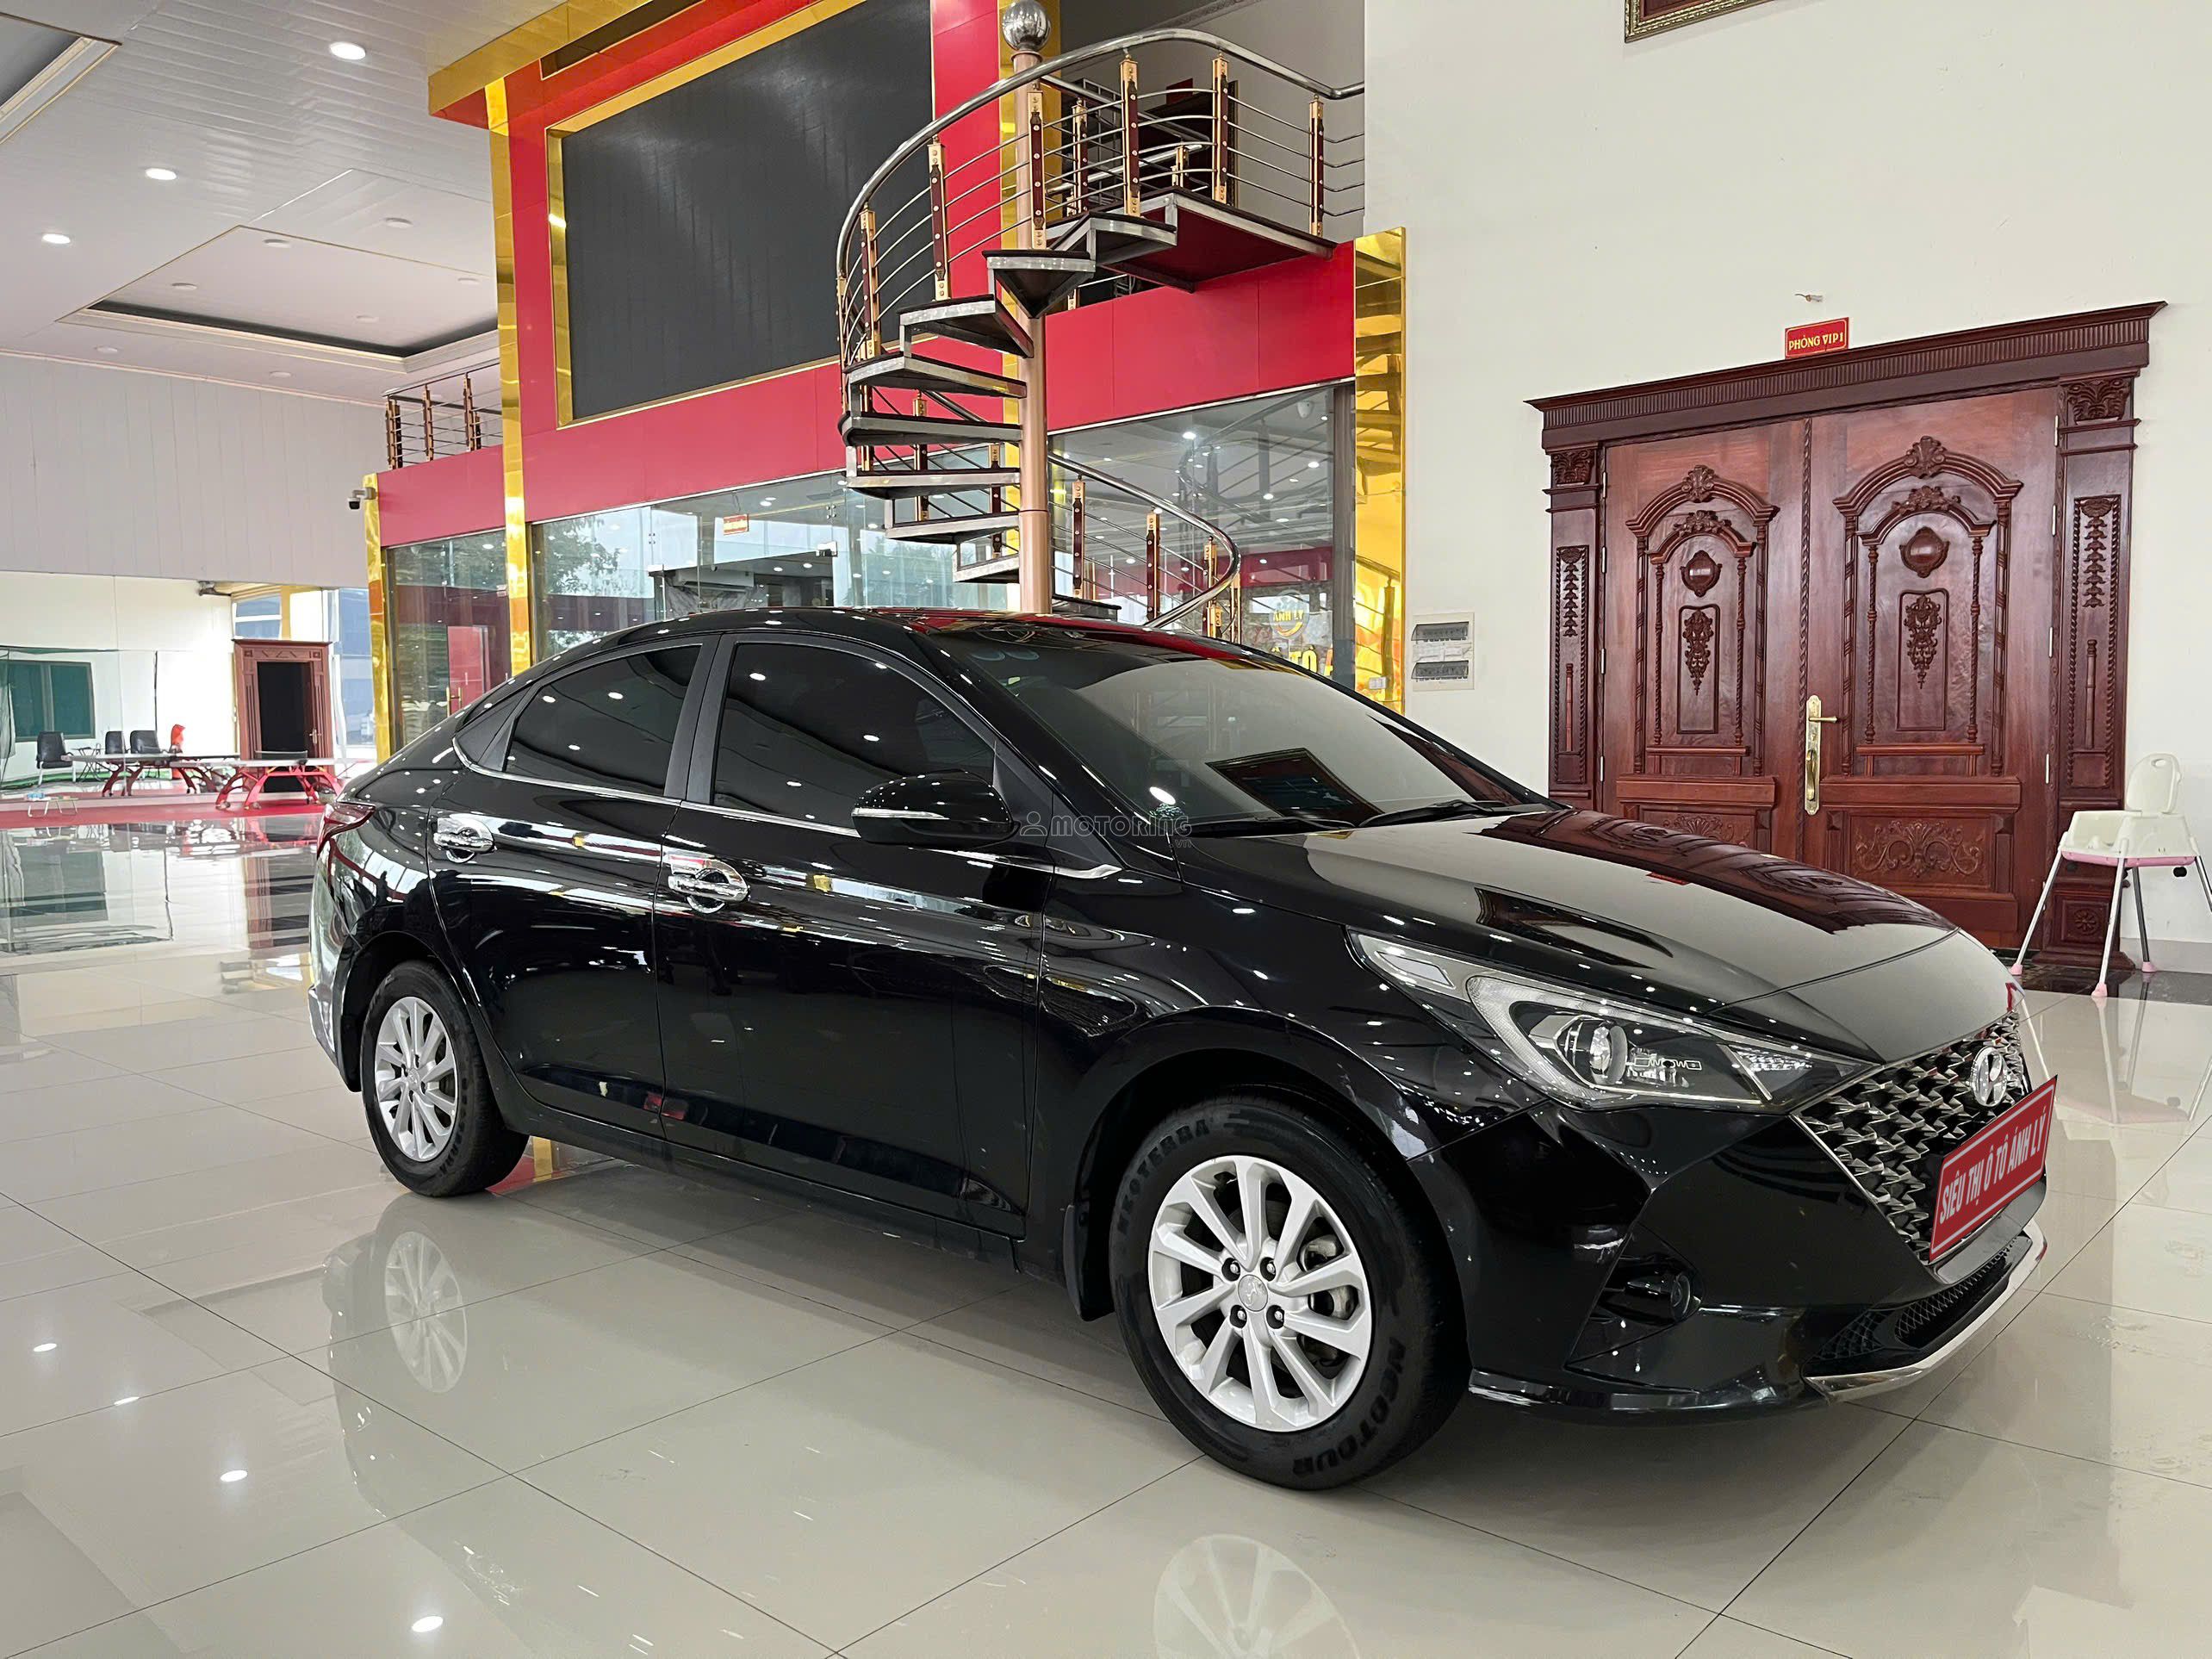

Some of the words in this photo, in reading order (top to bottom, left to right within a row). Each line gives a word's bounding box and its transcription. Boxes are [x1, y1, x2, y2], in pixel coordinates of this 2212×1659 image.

[1939, 1170, 1967, 1225] SIÊU
[1966, 1159, 1985, 1206] THỊ
[1984, 1144, 1994, 1192] Ô
[1994, 1134, 2009, 1185] TÔ
[2007, 1124, 2033, 1175] ÁNH
[2030, 1105, 2047, 1158] LÝ
